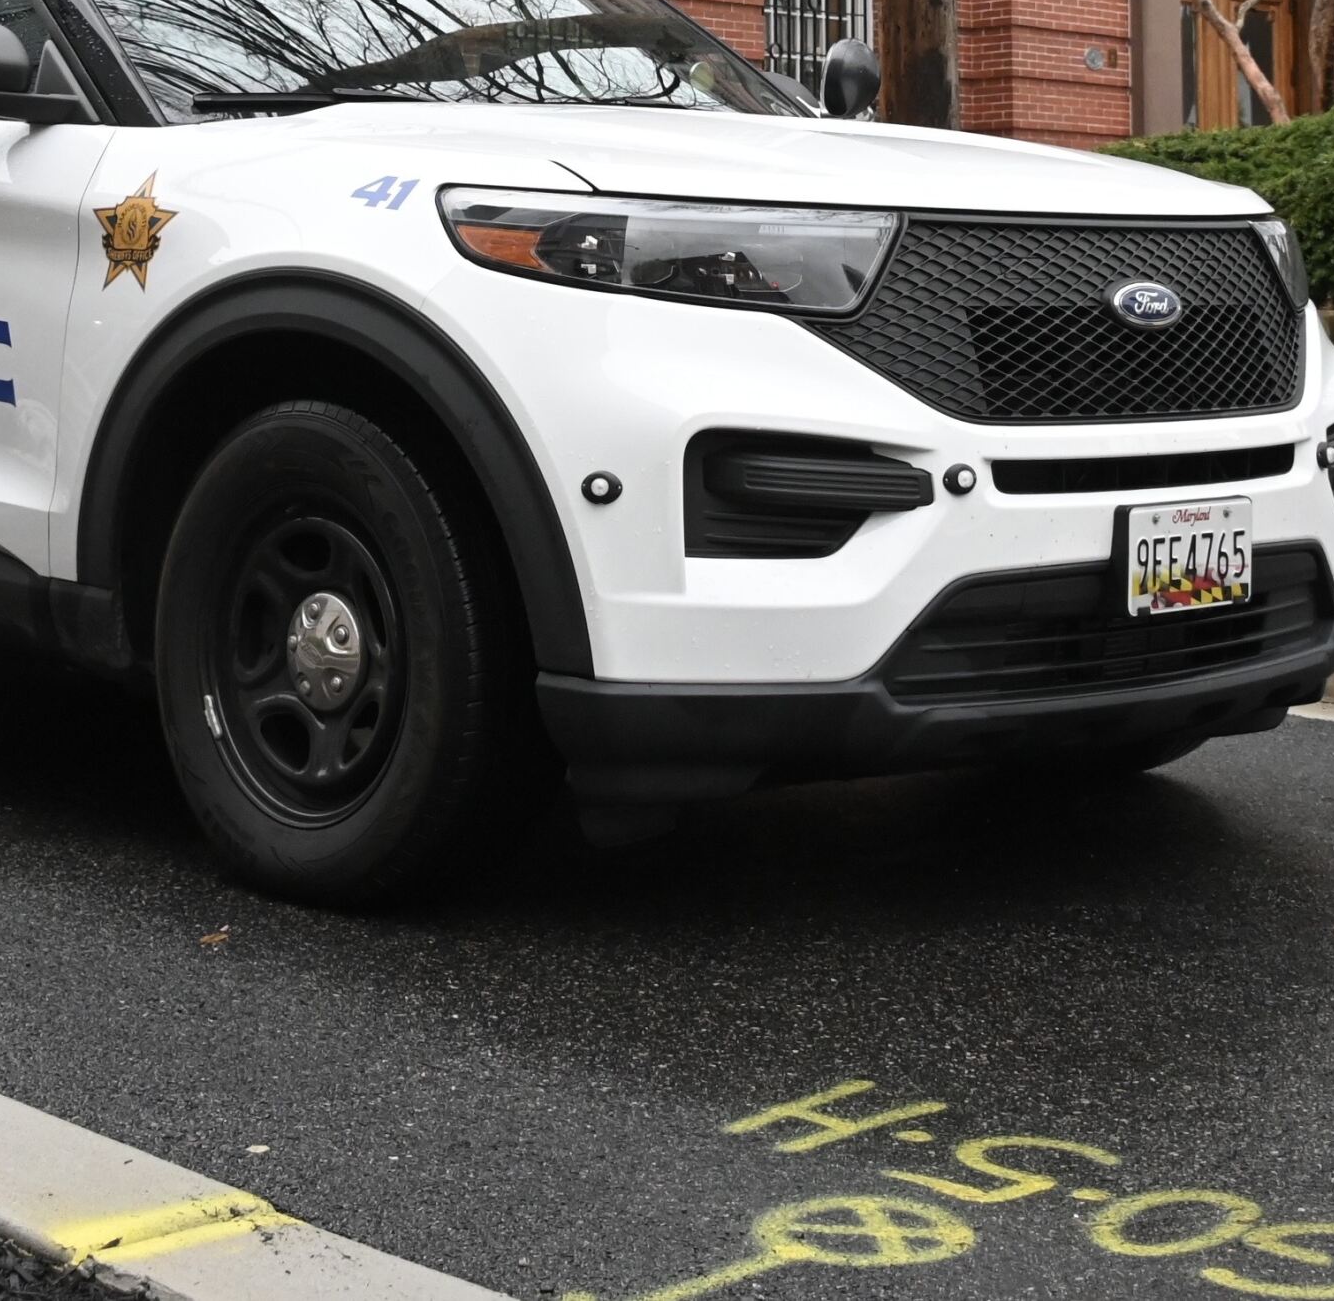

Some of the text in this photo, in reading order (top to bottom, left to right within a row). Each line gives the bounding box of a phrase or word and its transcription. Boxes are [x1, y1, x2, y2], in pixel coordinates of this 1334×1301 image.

[350, 175, 420, 211] 41
[1134, 290, 1170, 315] Ford
[1172, 506, 1212, 527] Maryland
